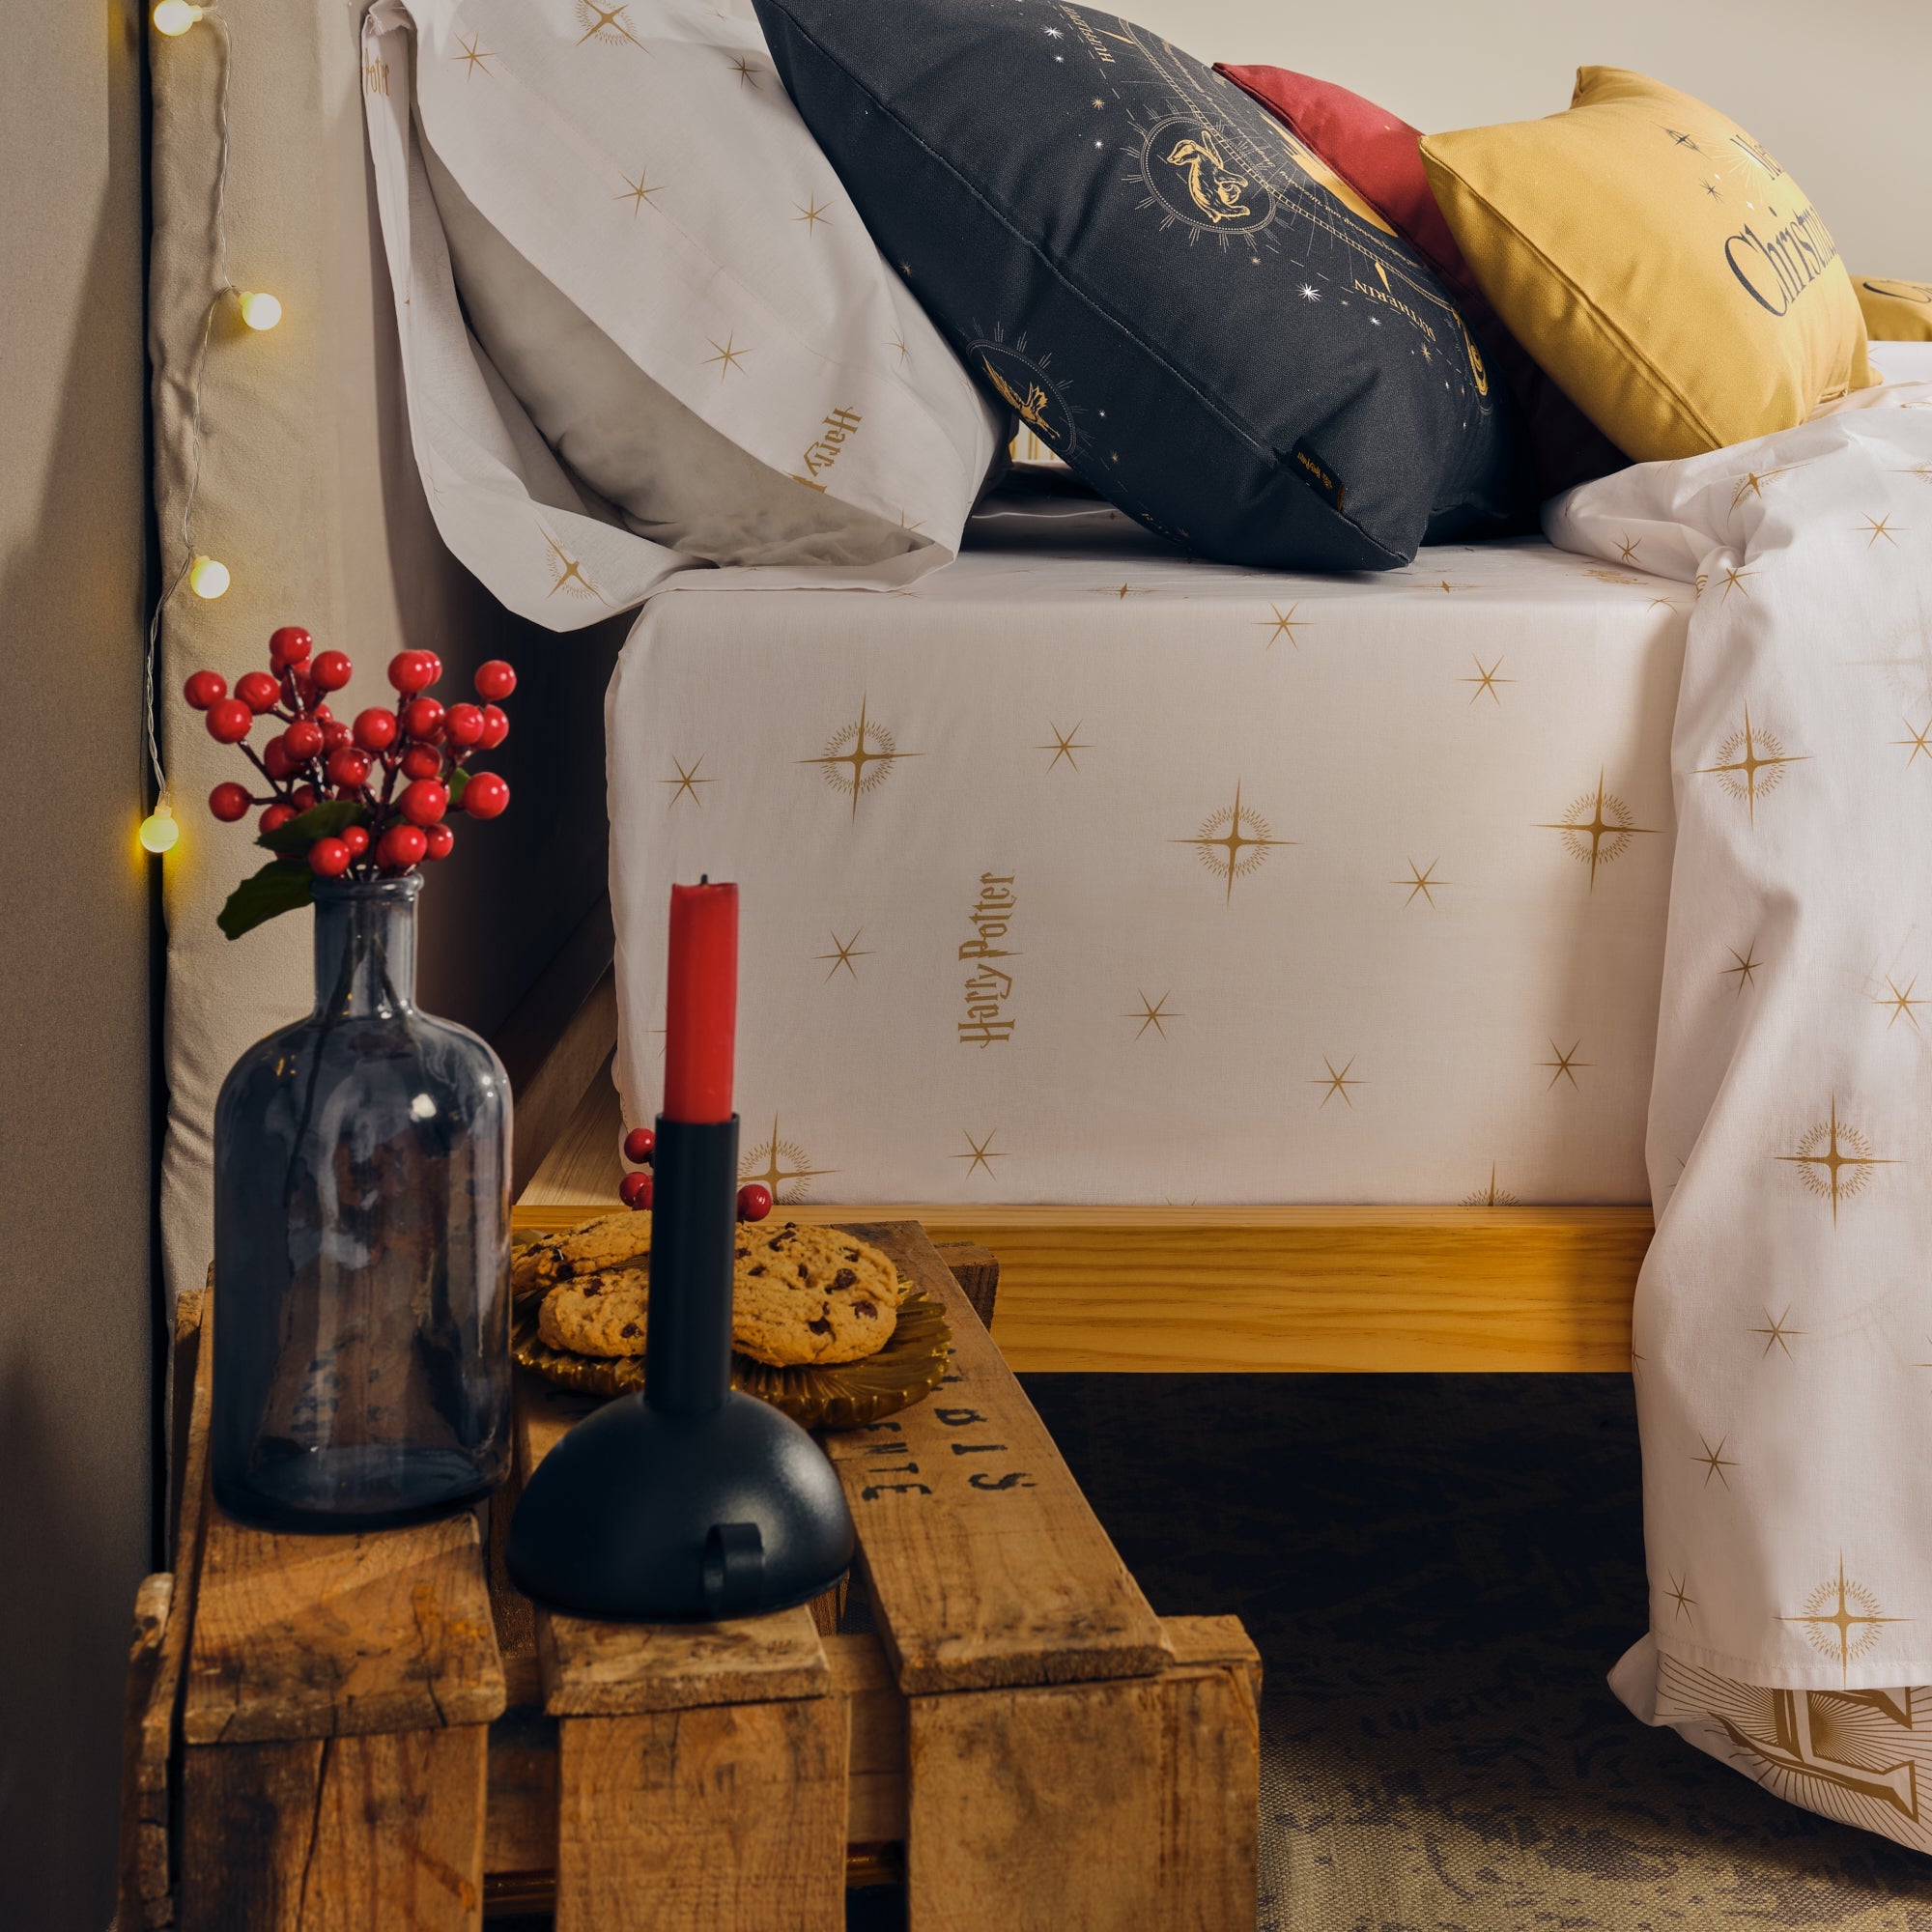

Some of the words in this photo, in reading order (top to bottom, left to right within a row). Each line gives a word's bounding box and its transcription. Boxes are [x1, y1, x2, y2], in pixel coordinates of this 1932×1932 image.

[803, 406, 863, 477] Harry
[958, 871, 1024, 961] Potter
[957, 963, 1015, 1050] Harry
